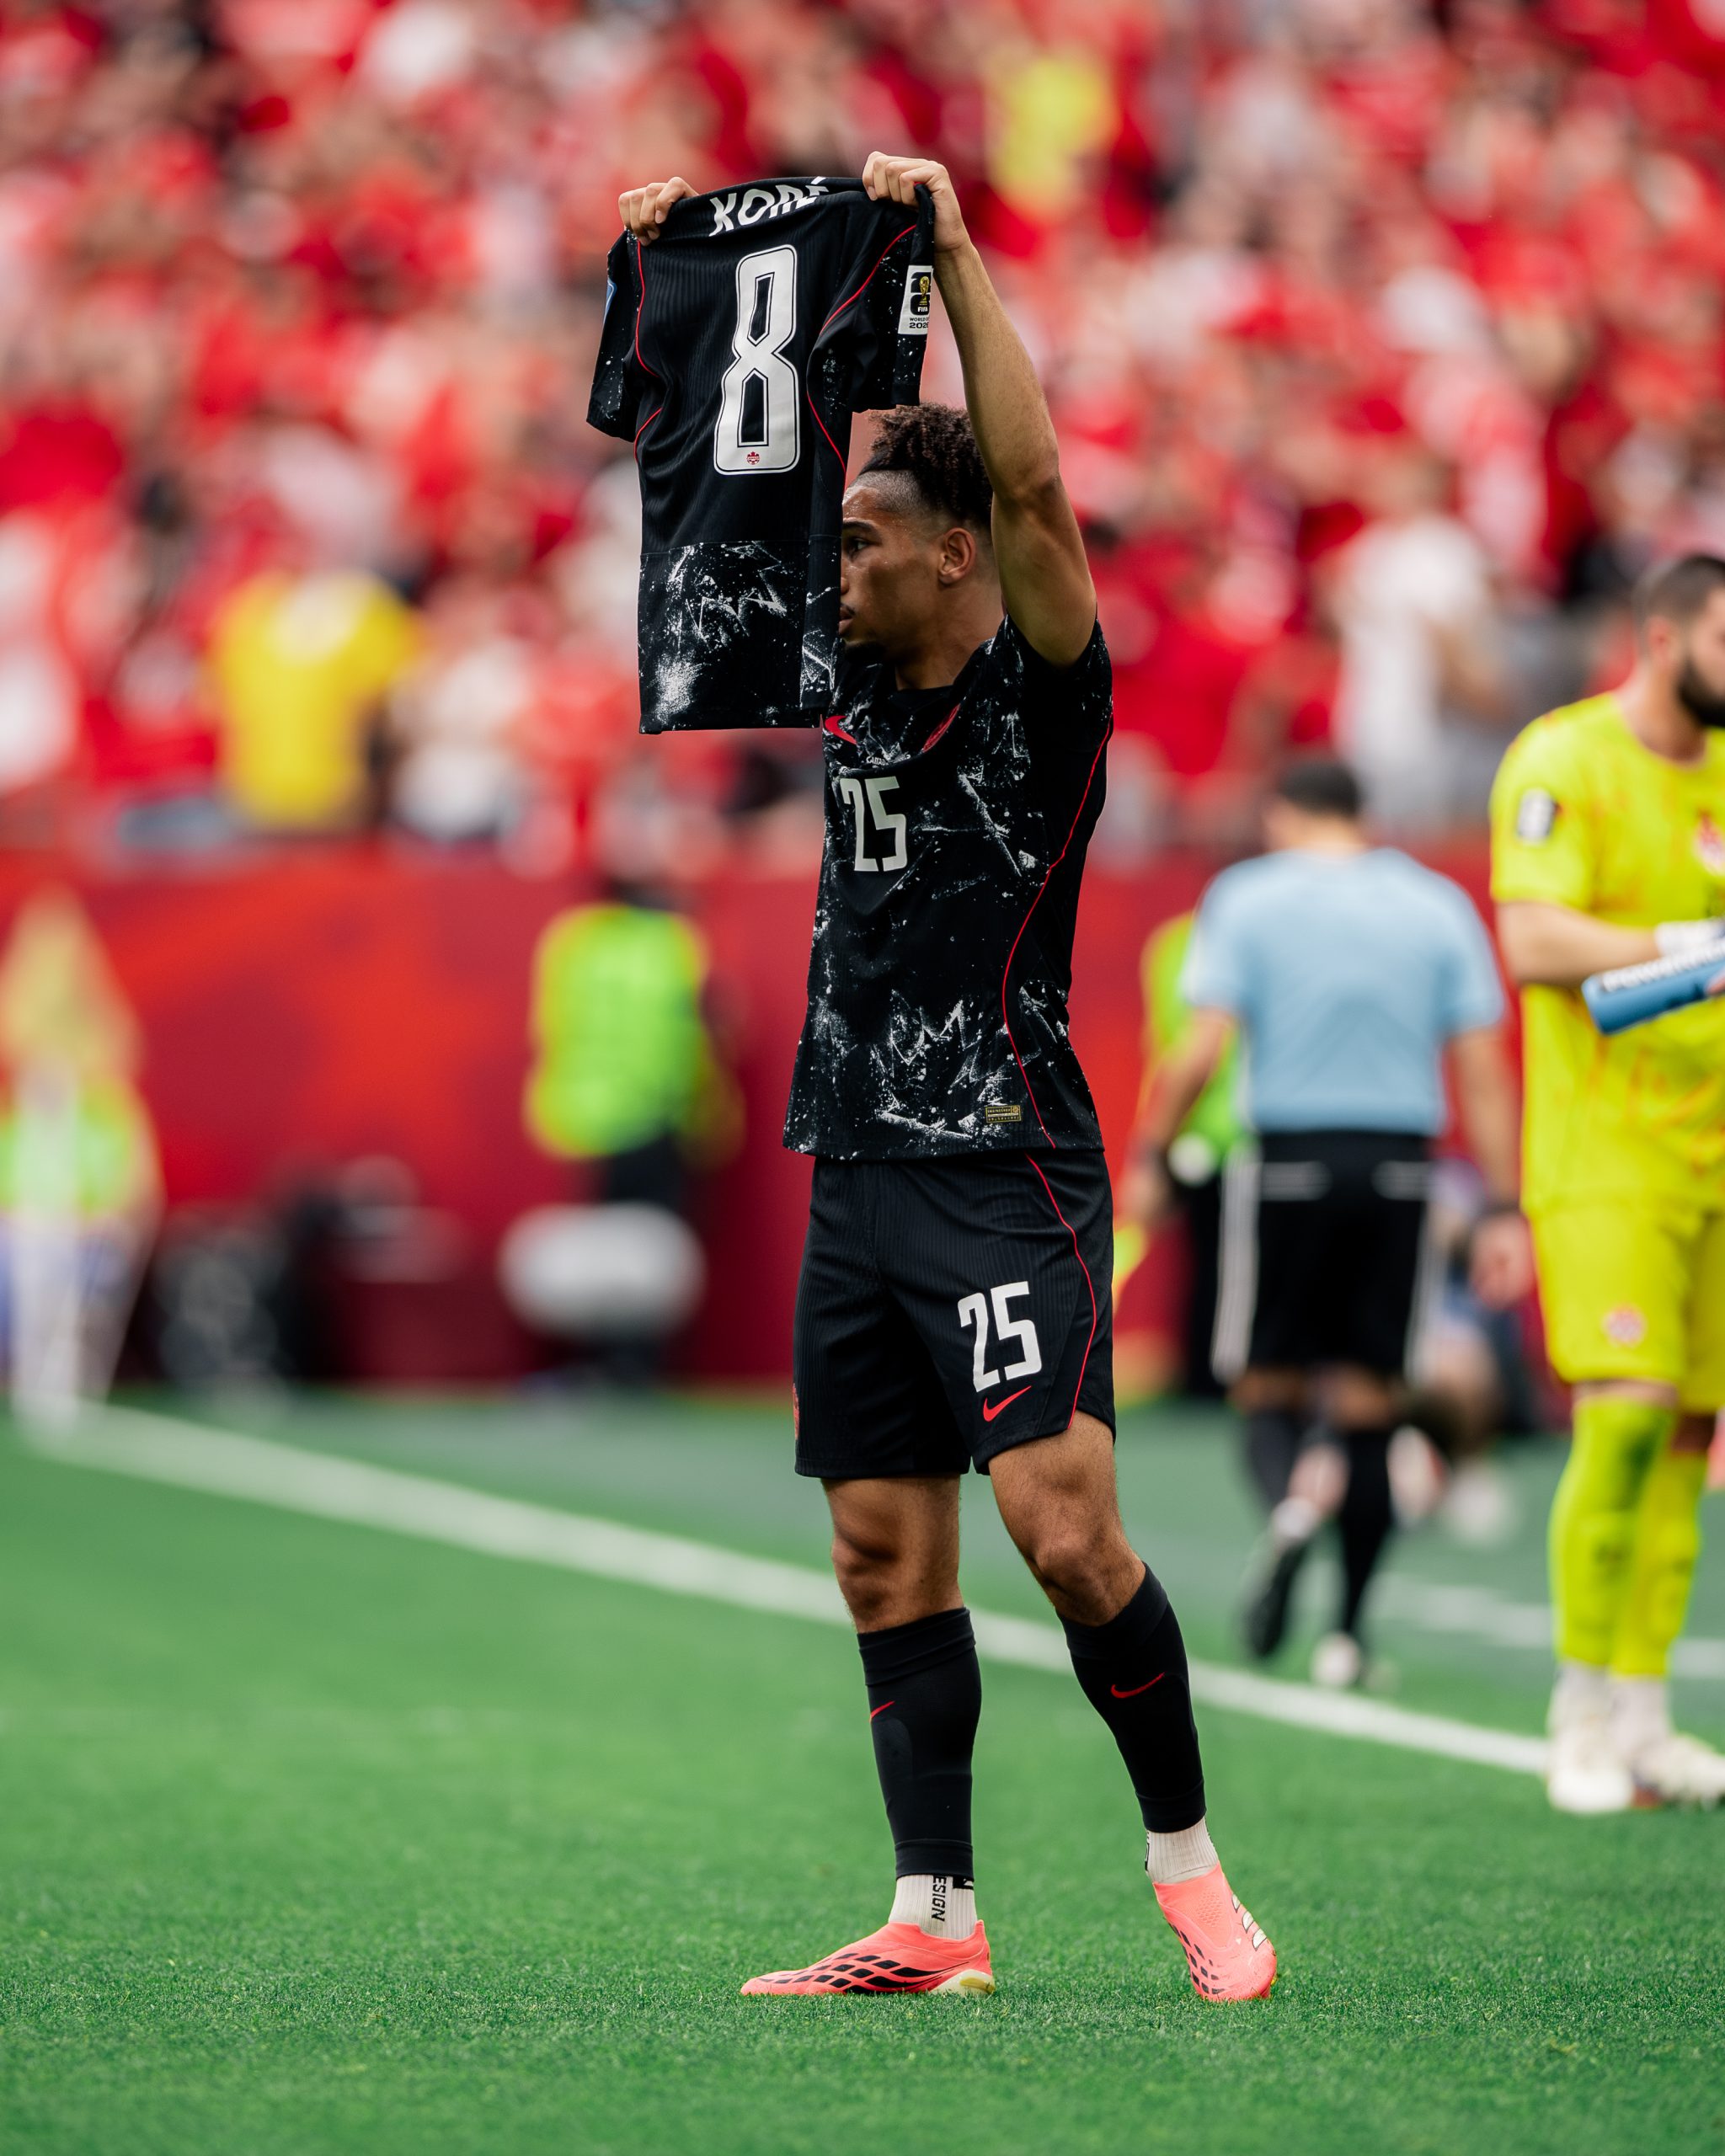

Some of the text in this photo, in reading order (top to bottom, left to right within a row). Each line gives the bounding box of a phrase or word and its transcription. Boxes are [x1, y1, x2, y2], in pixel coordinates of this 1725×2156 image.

[713, 244, 800, 475] 8
[840, 776, 907, 872] 25
[958, 1281, 1042, 1392] 25
